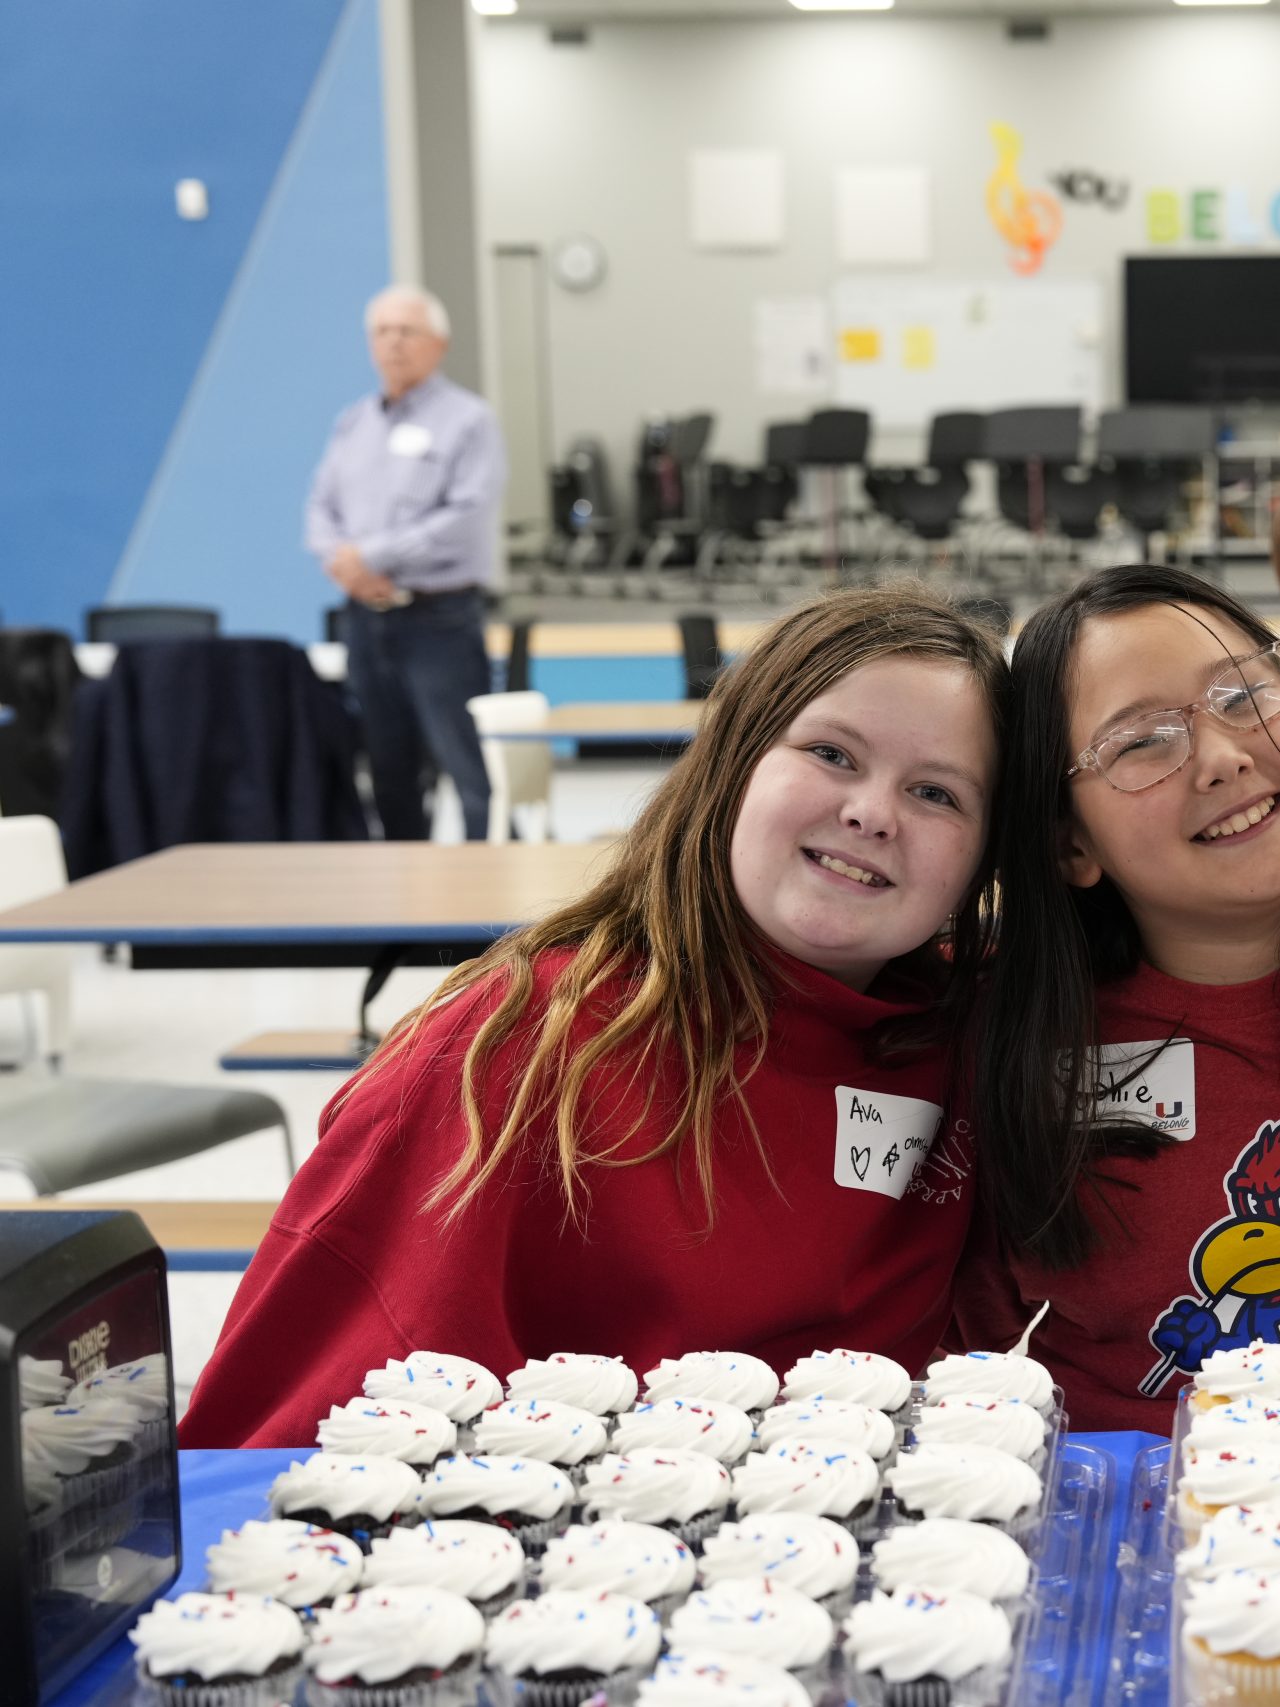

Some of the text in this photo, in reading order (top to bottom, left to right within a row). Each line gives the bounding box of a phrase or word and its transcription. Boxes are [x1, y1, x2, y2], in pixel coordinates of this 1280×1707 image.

[1051, 167, 1129, 212] YOU
[850, 1096, 883, 1125] Ava
[1155, 1101, 1183, 1119] U
[1151, 1118, 1190, 1129] BELONG
